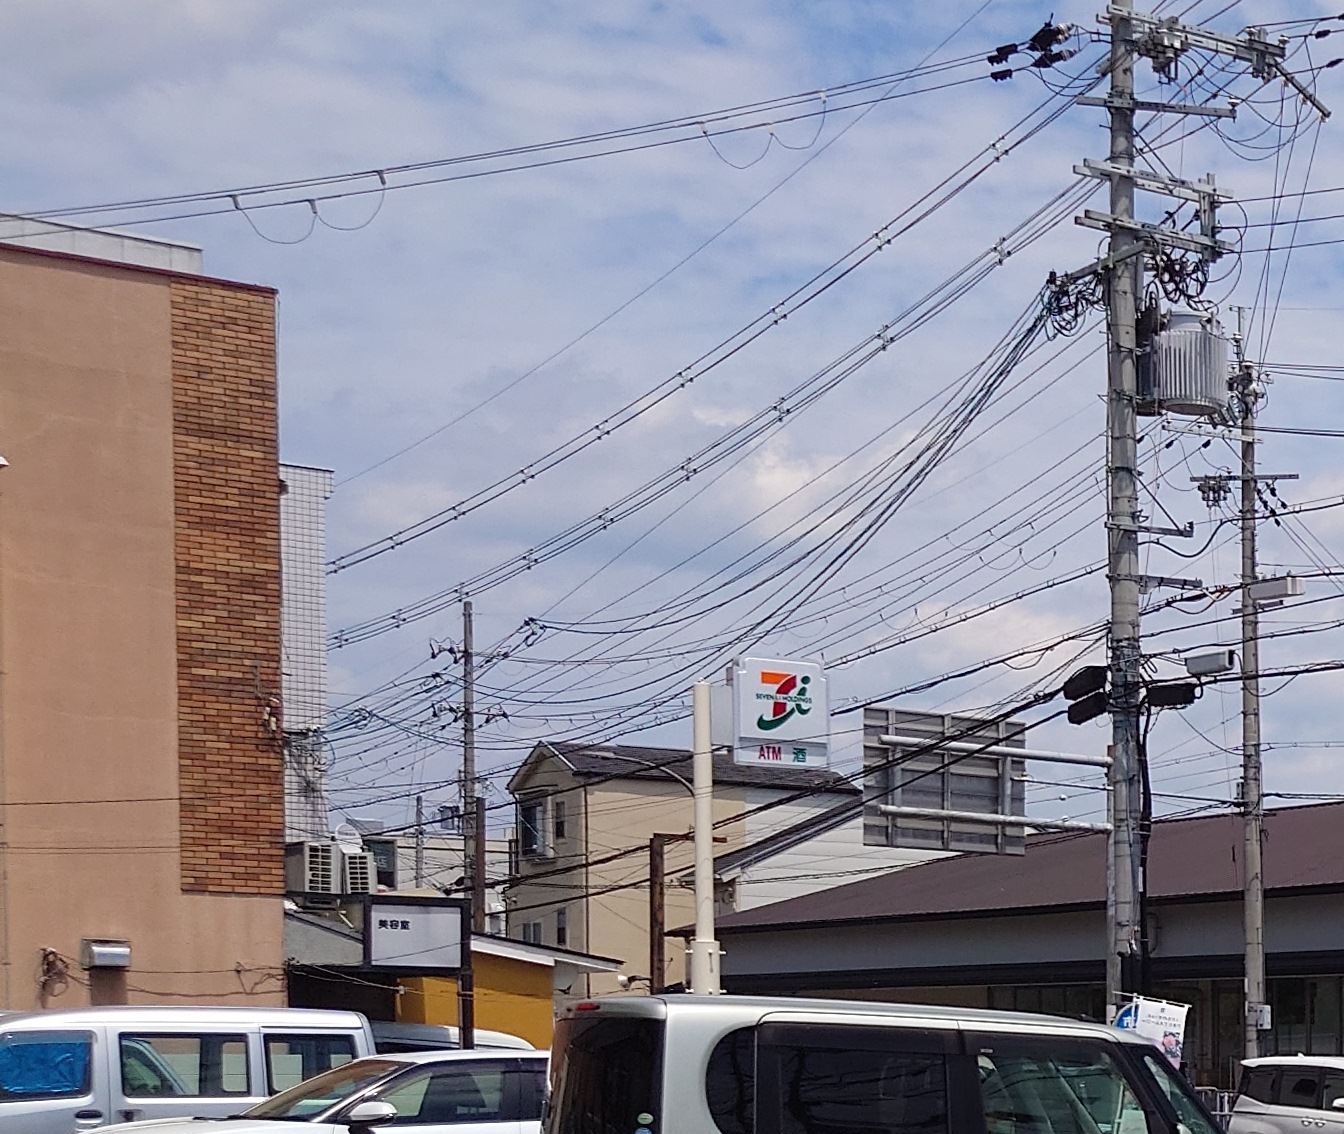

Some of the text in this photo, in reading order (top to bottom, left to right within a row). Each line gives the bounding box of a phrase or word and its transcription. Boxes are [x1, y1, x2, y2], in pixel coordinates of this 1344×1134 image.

[758, 746, 782, 760] ATM
[793, 747, 807, 762] 酒
[378, 919, 411, 931] 美容室
